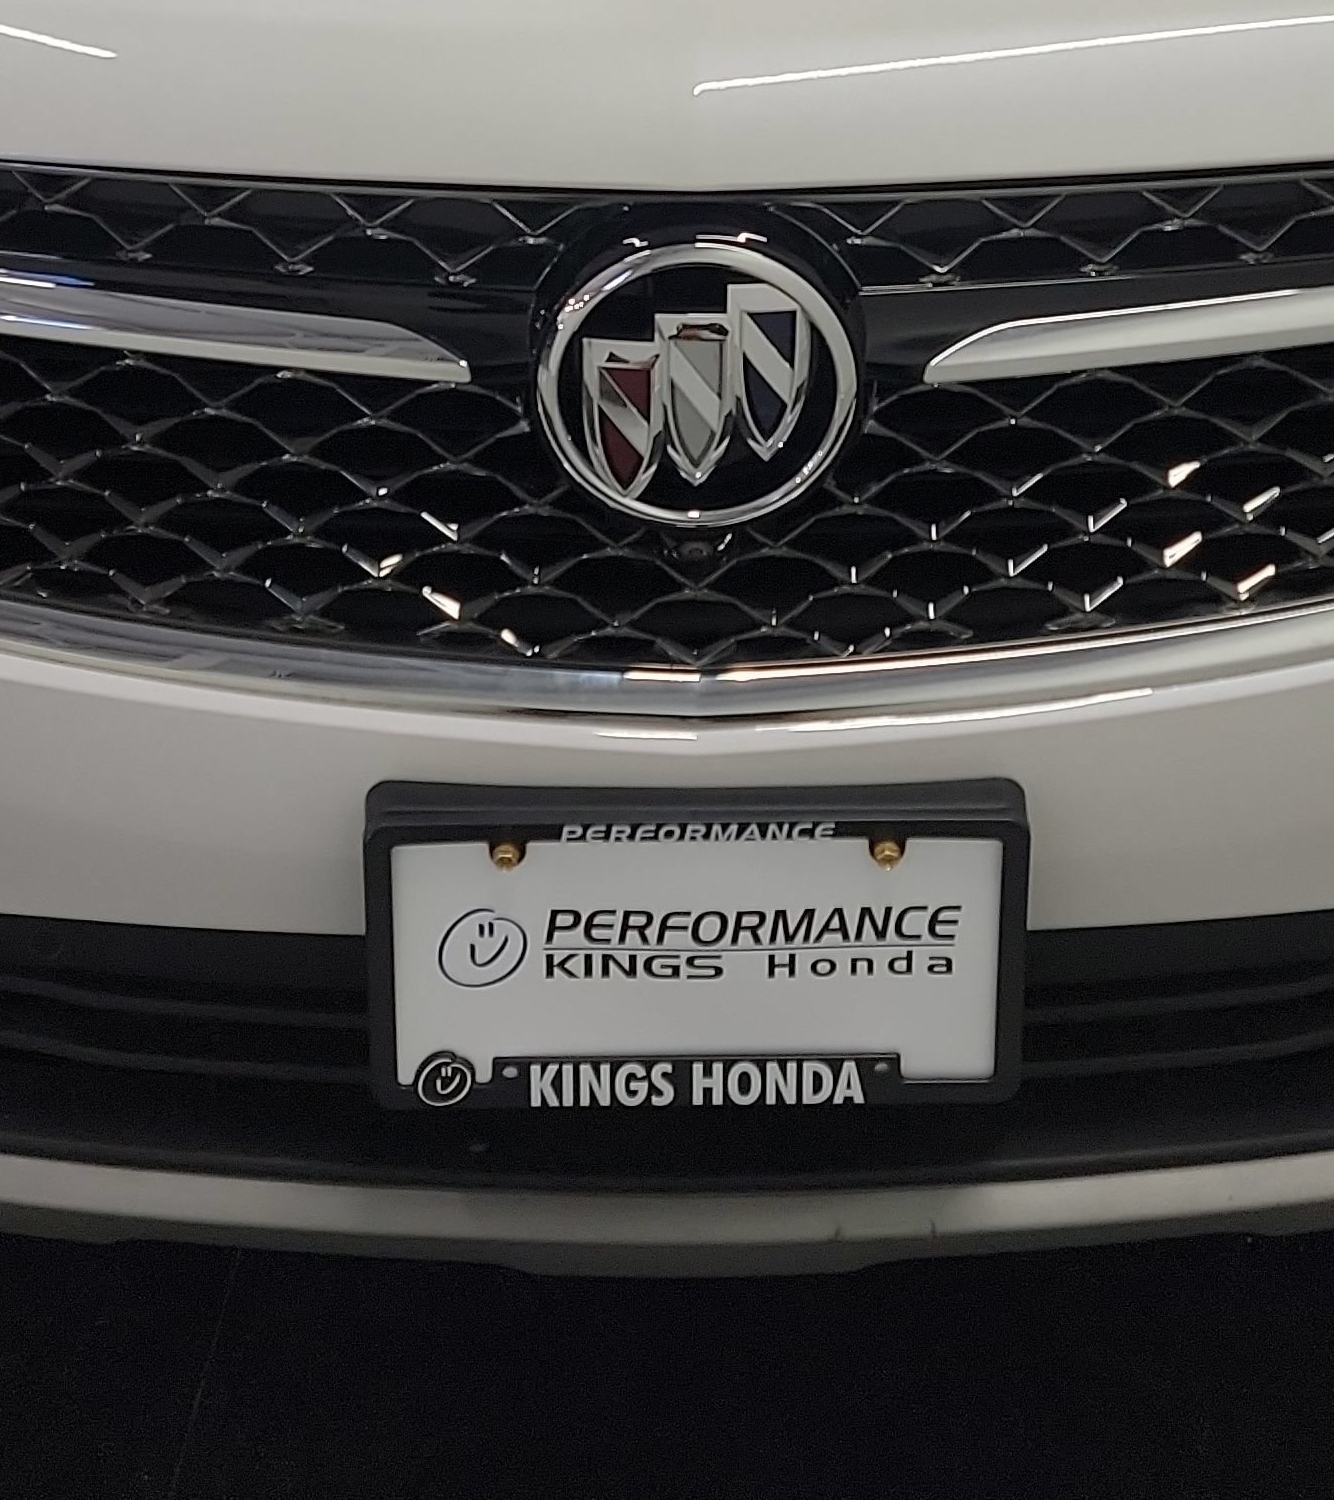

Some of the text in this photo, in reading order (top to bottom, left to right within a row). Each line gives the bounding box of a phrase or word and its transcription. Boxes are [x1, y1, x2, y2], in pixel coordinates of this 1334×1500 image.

[560, 822, 836, 843] PERFORMANCE
[544, 905, 963, 947] PERFORMANCE
[545, 950, 954, 980] KINGS Honda
[529, 1060, 866, 1108] KINGS HONDA
